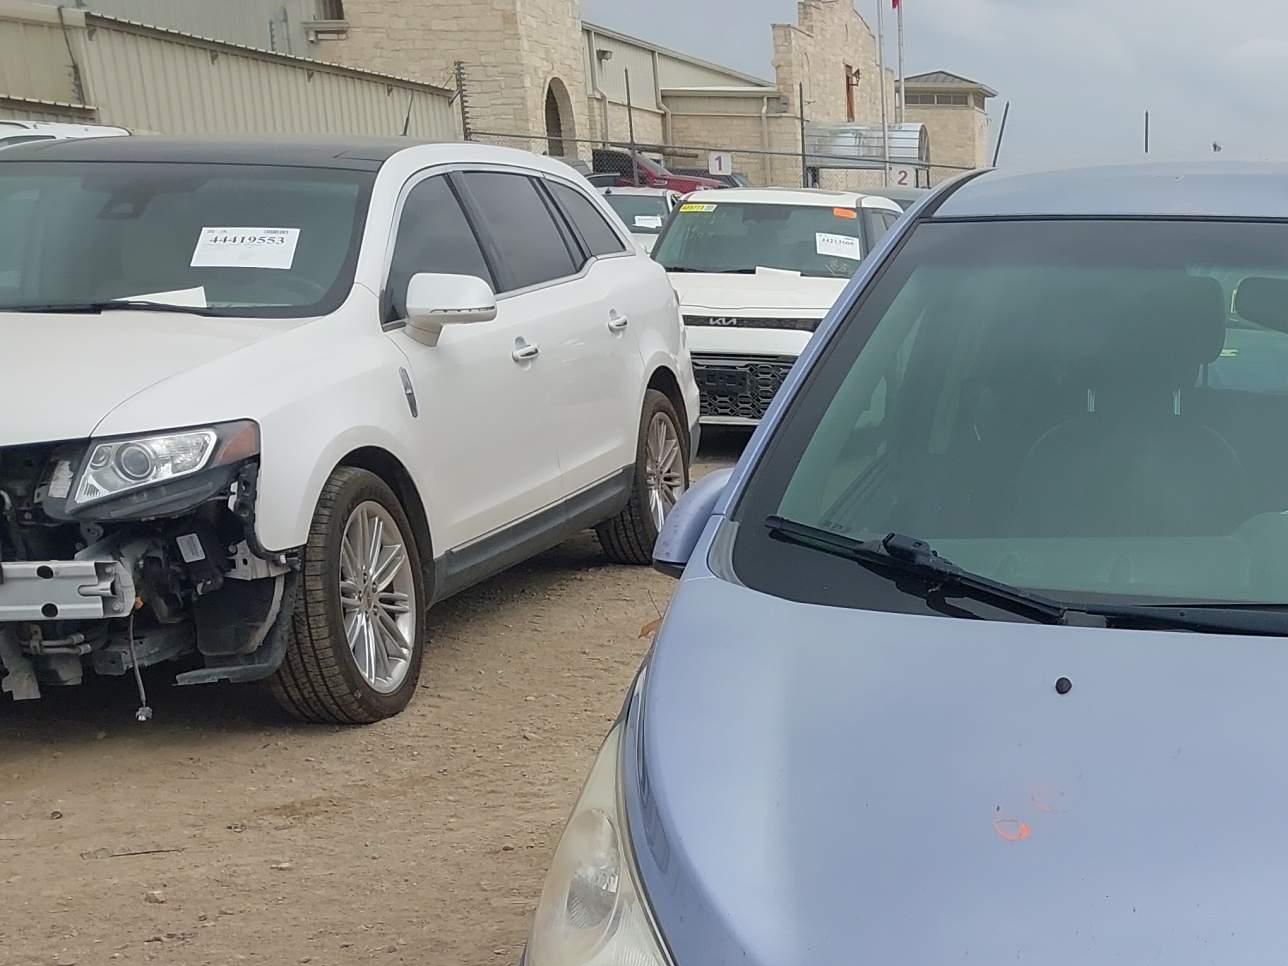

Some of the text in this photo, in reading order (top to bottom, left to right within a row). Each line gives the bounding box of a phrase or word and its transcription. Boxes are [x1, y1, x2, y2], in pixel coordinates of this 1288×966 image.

[714, 155, 722, 171] 1
[897, 170, 909, 186] 2
[209, 235, 285, 245] 44419553
